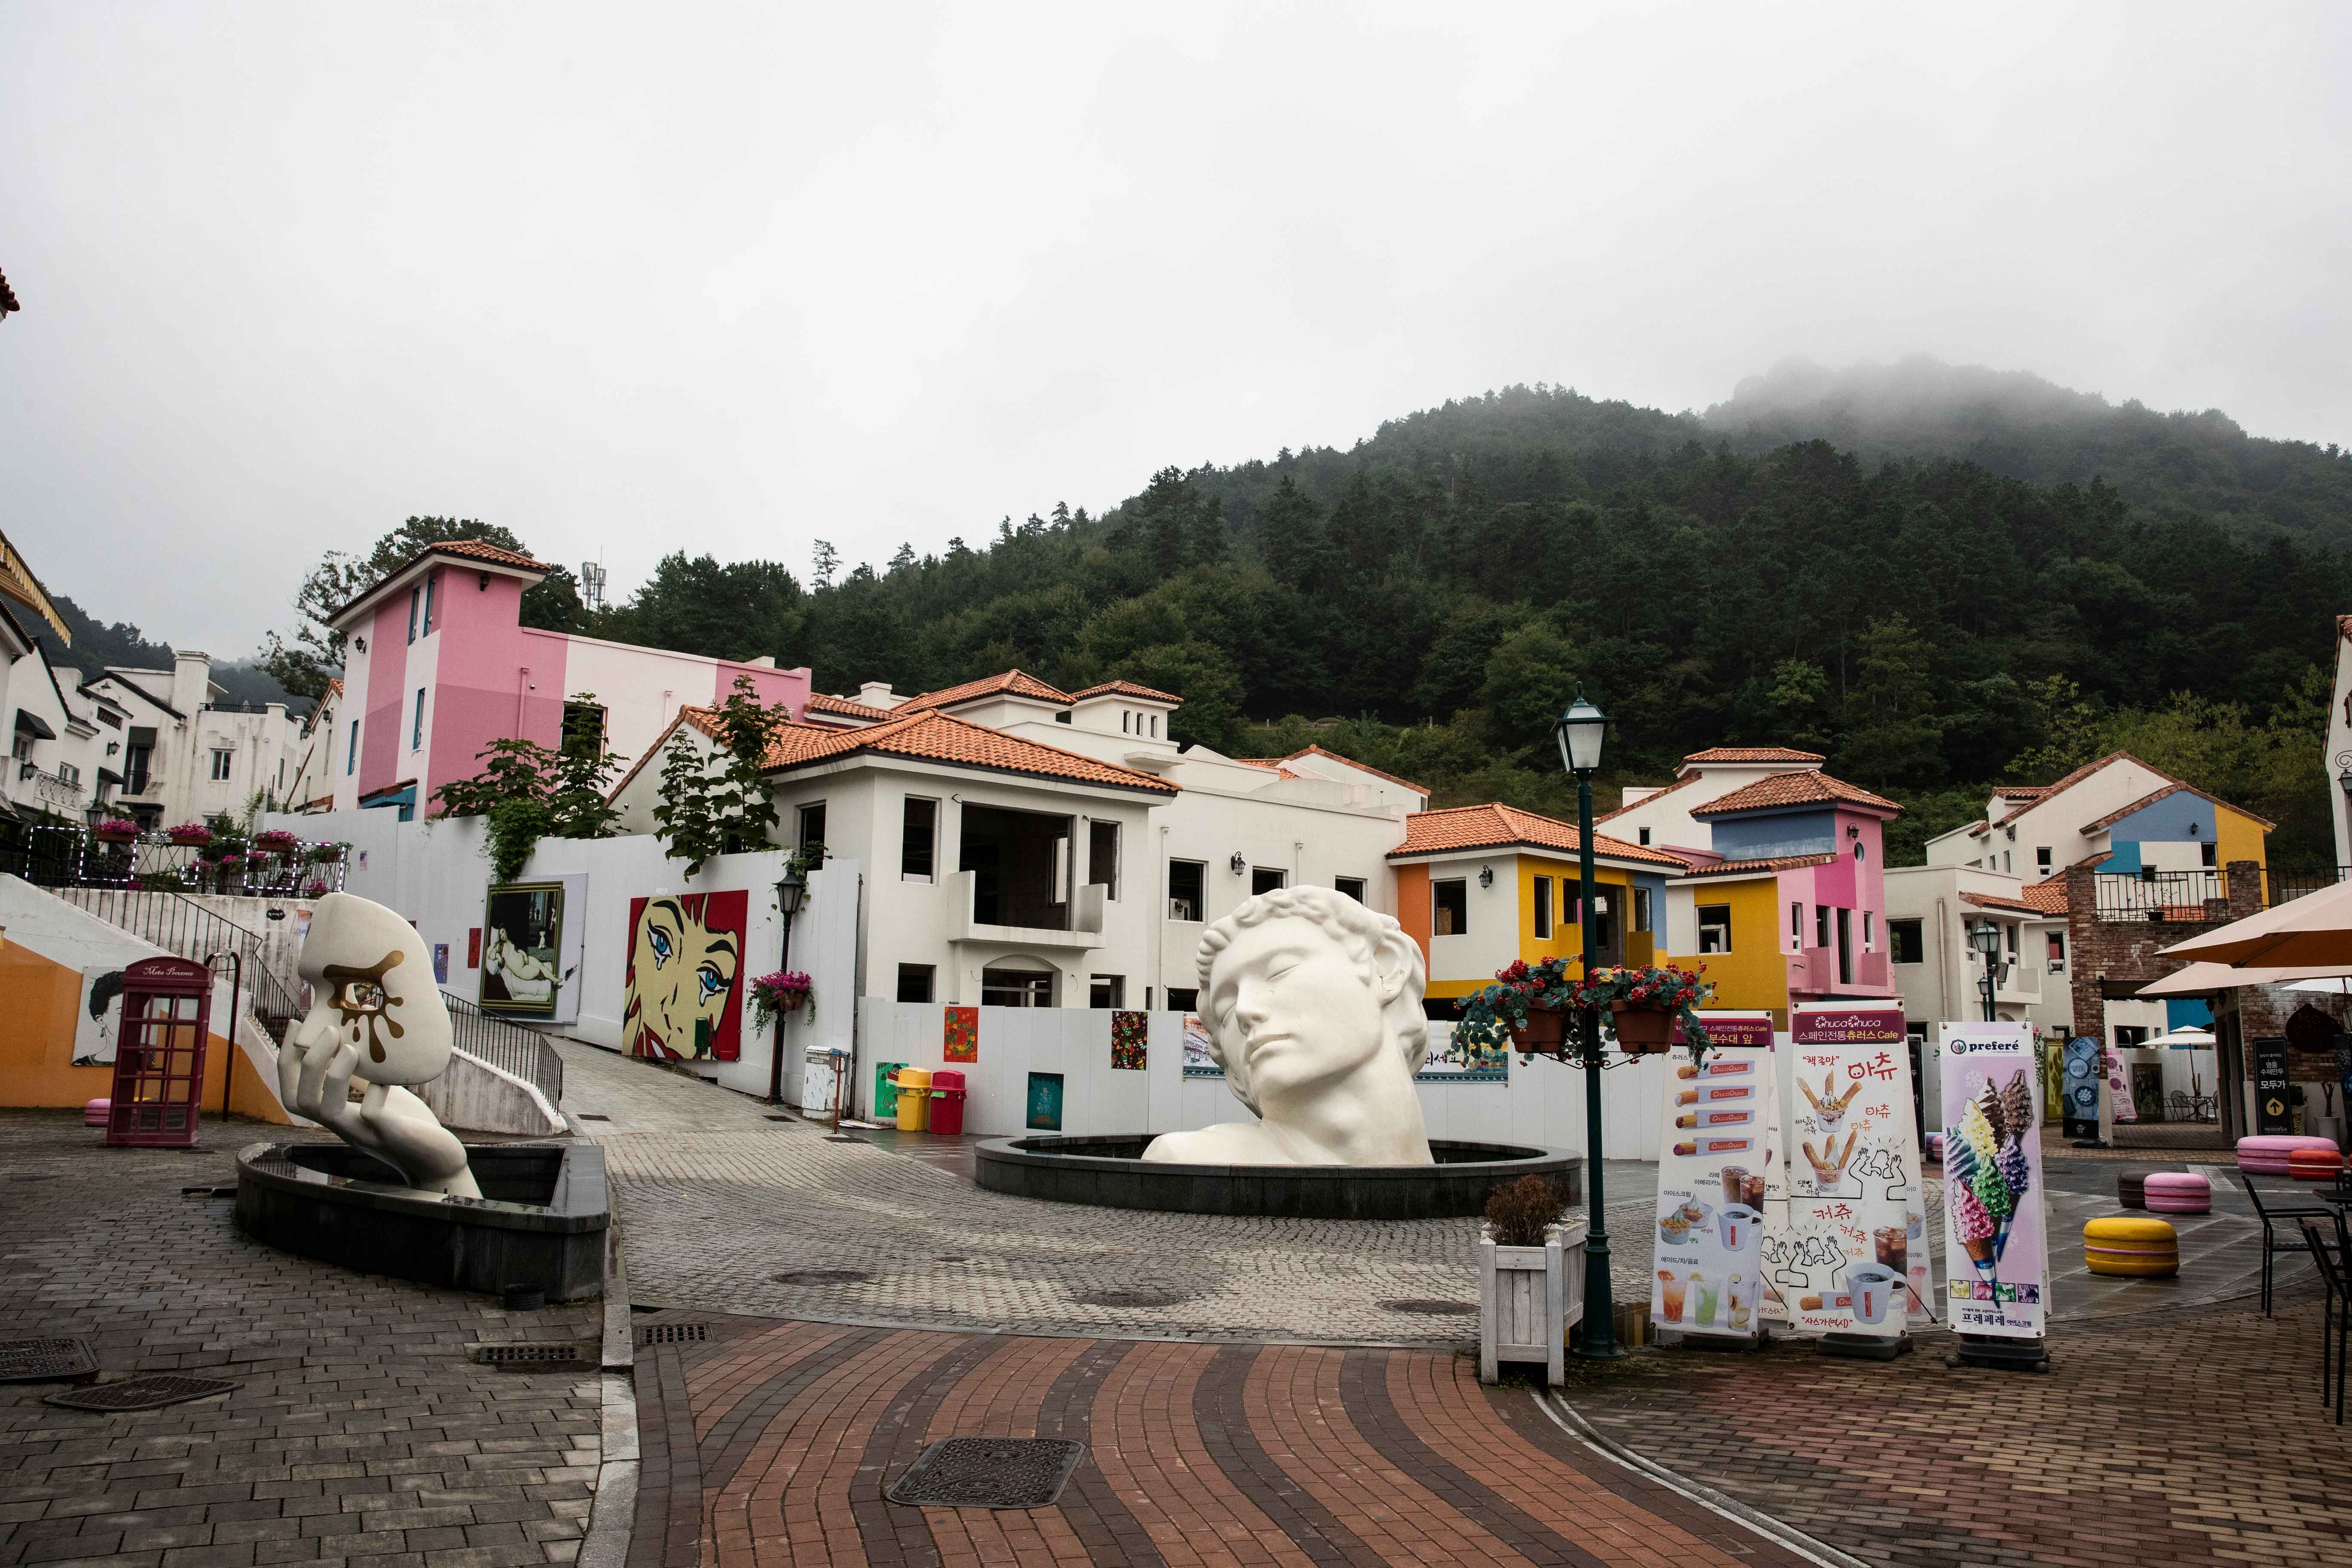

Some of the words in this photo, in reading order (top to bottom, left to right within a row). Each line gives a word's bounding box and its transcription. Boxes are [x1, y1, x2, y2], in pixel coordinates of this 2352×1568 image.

[143, 966, 165, 975] Meta
[166, 967, 194, 976] Provence
[1707, 1034, 1737, 1044] 분수대
[1743, 1034, 1753, 1044] 앞
[1969, 1039, 2019, 1052] preferé
[2260, 1080, 2286, 1089] 모두가
[1813, 1203, 1853, 1220] 커츄
[1661, 1256, 1699, 1265] 에이드/차/음료
[1962, 1313, 2005, 1326] 프레페레
